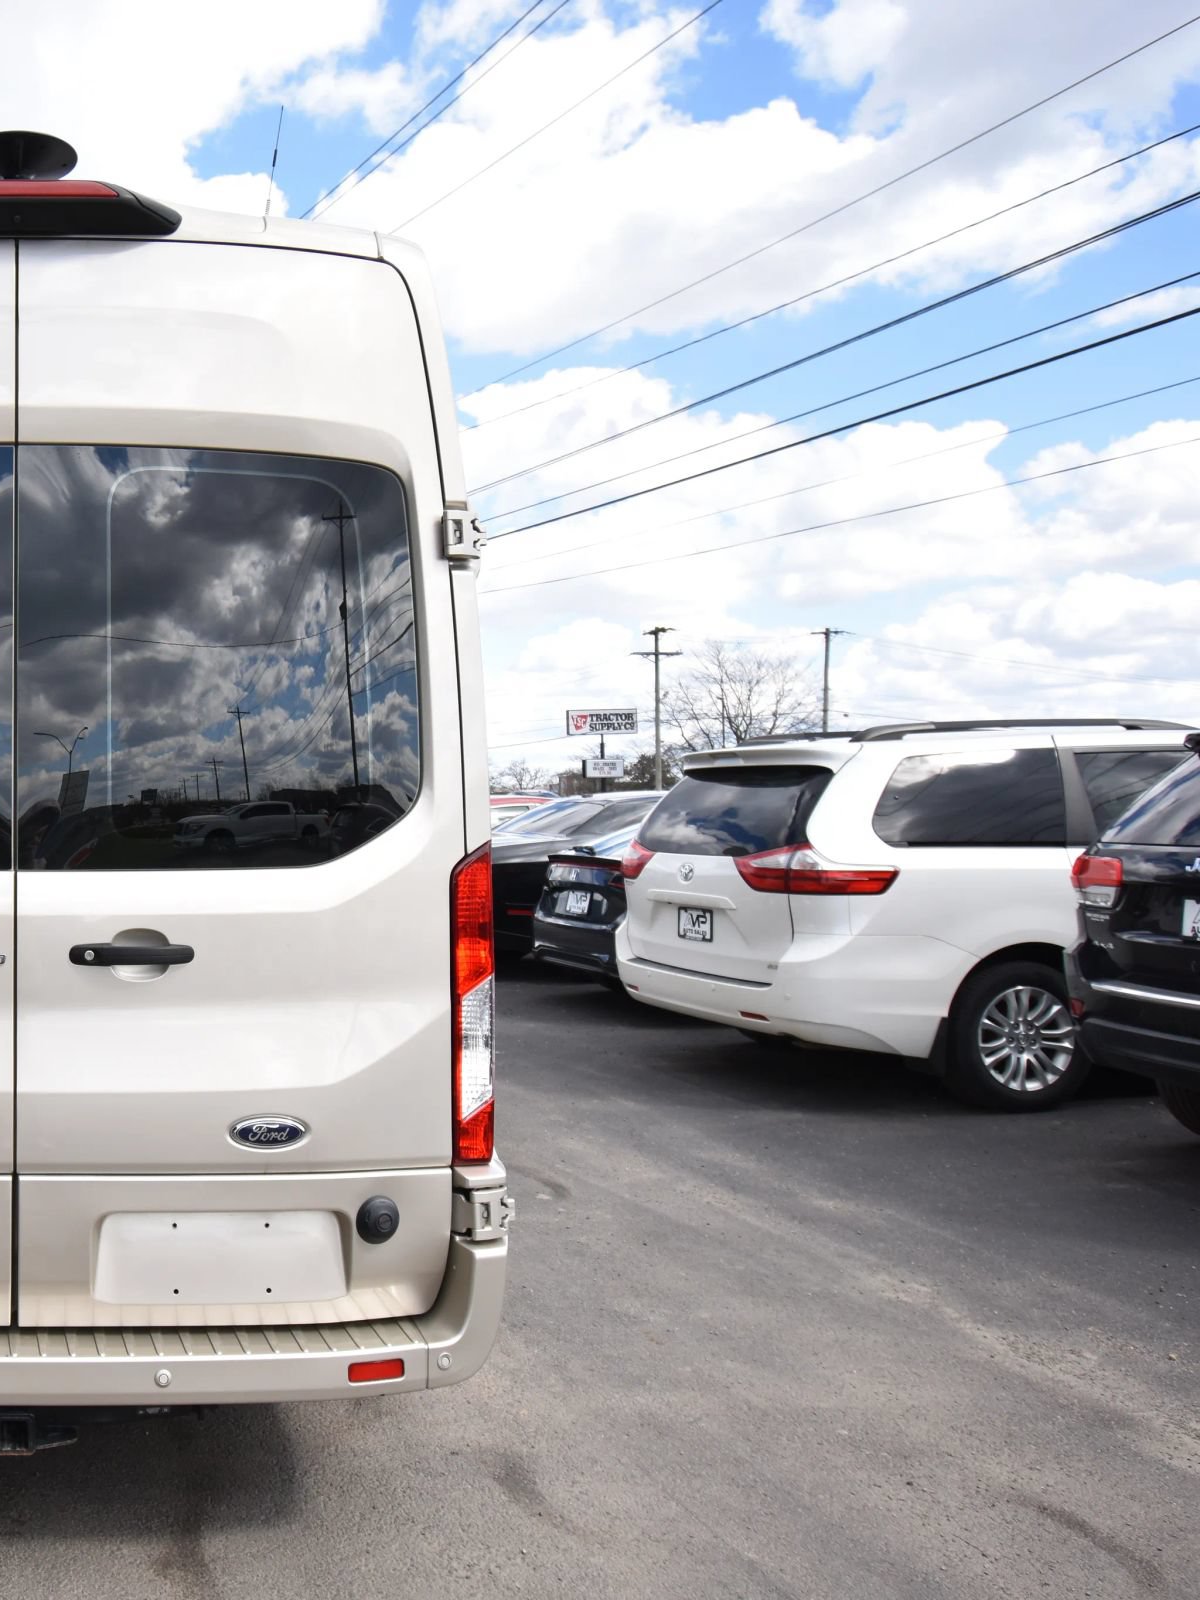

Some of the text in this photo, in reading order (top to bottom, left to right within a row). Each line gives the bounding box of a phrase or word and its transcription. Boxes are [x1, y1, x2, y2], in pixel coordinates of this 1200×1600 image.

[588, 713, 634, 722] TRACTOR
[589, 722, 622, 731] SUPPLY
[248, 1123, 289, 1142] Ford
